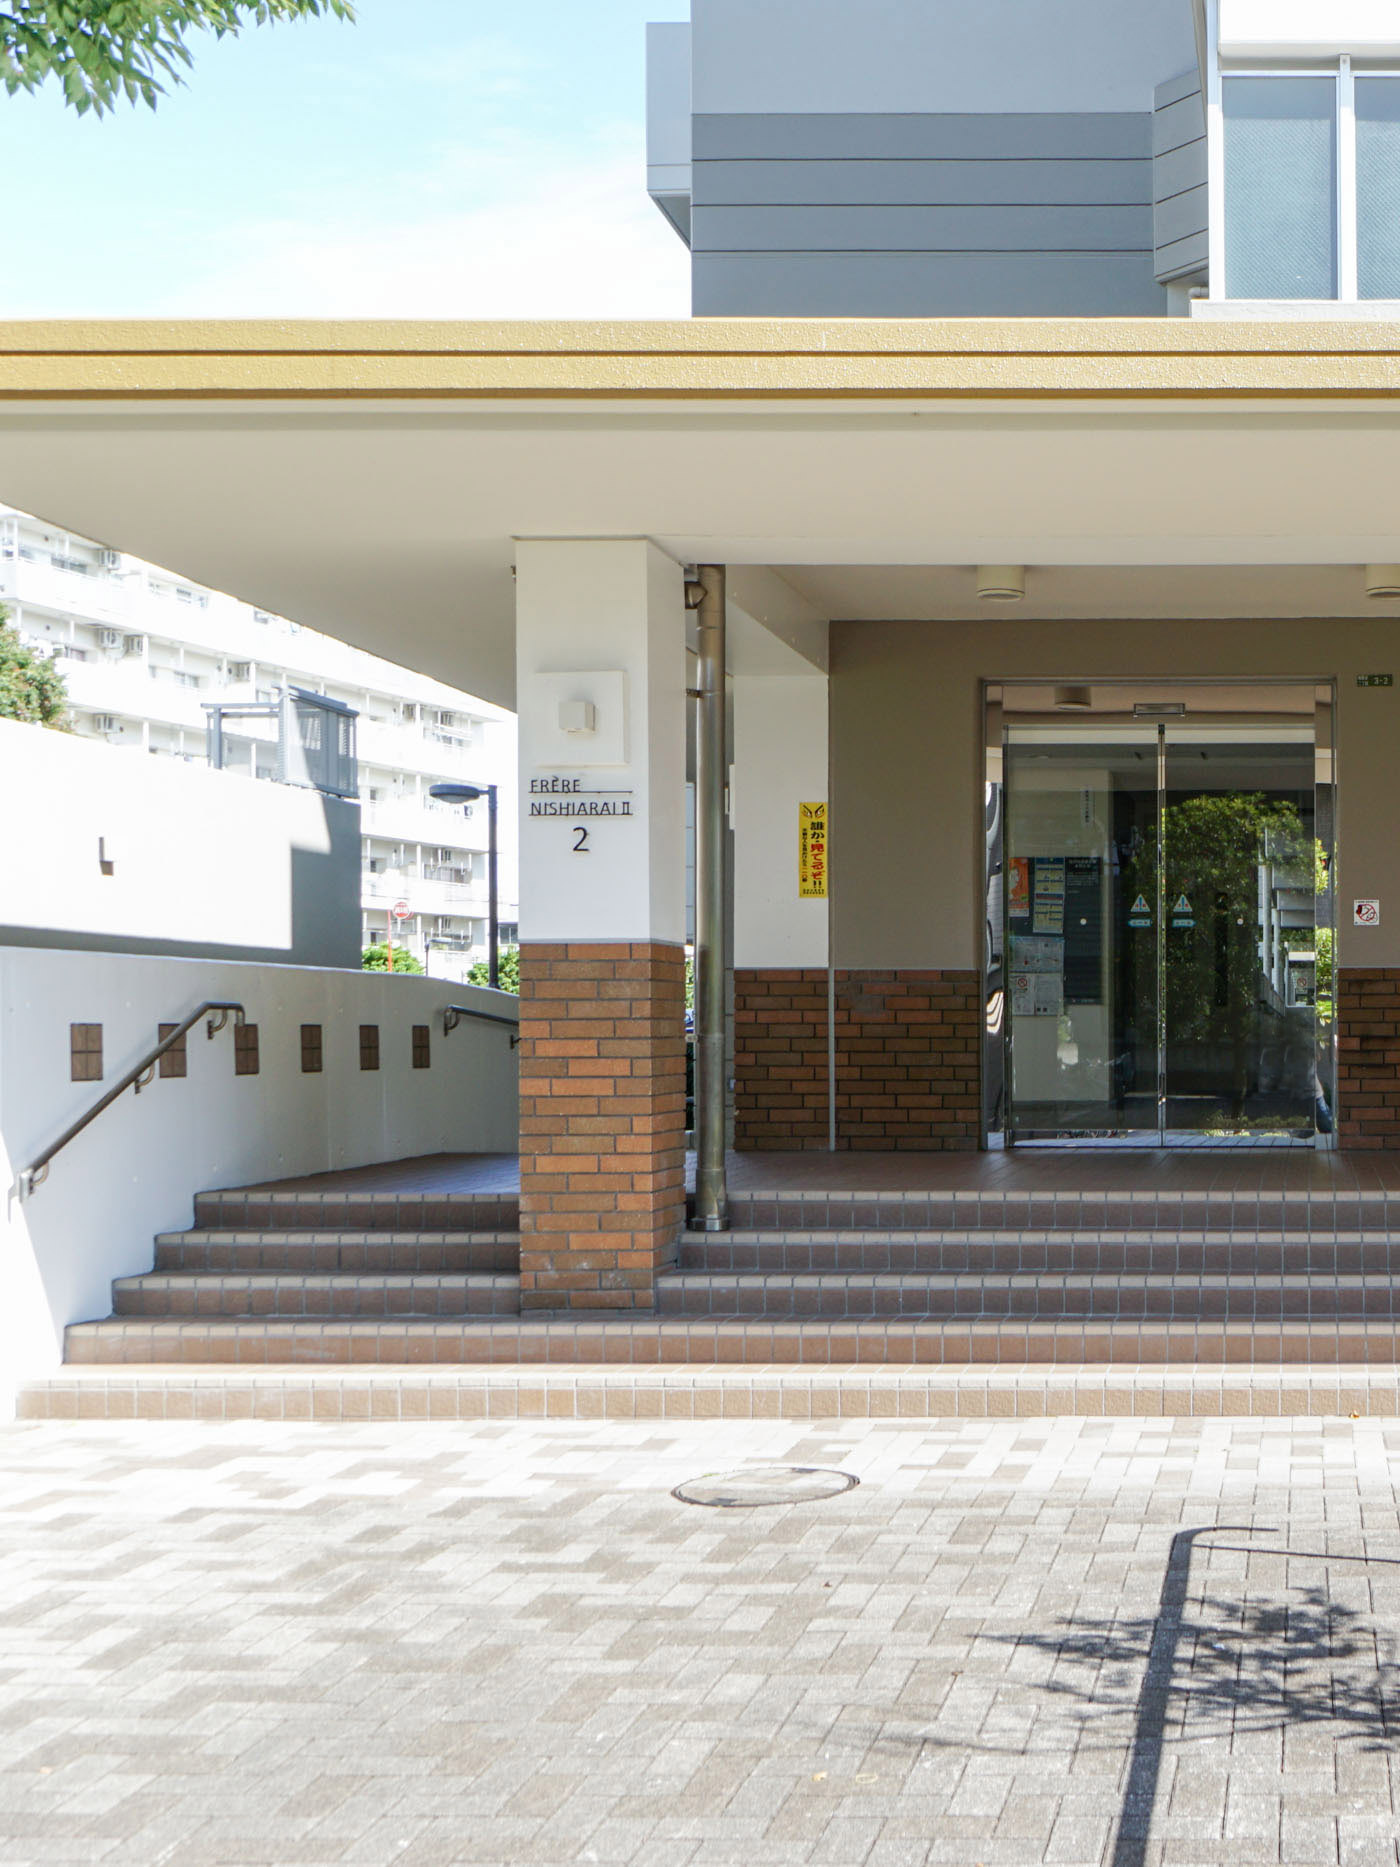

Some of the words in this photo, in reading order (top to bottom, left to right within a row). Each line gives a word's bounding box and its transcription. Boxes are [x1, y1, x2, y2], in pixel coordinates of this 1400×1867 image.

[530, 775, 581, 793] FRÈRE
[530, 801, 616, 816] NISHIARAI
[572, 826, 590, 852] 2
